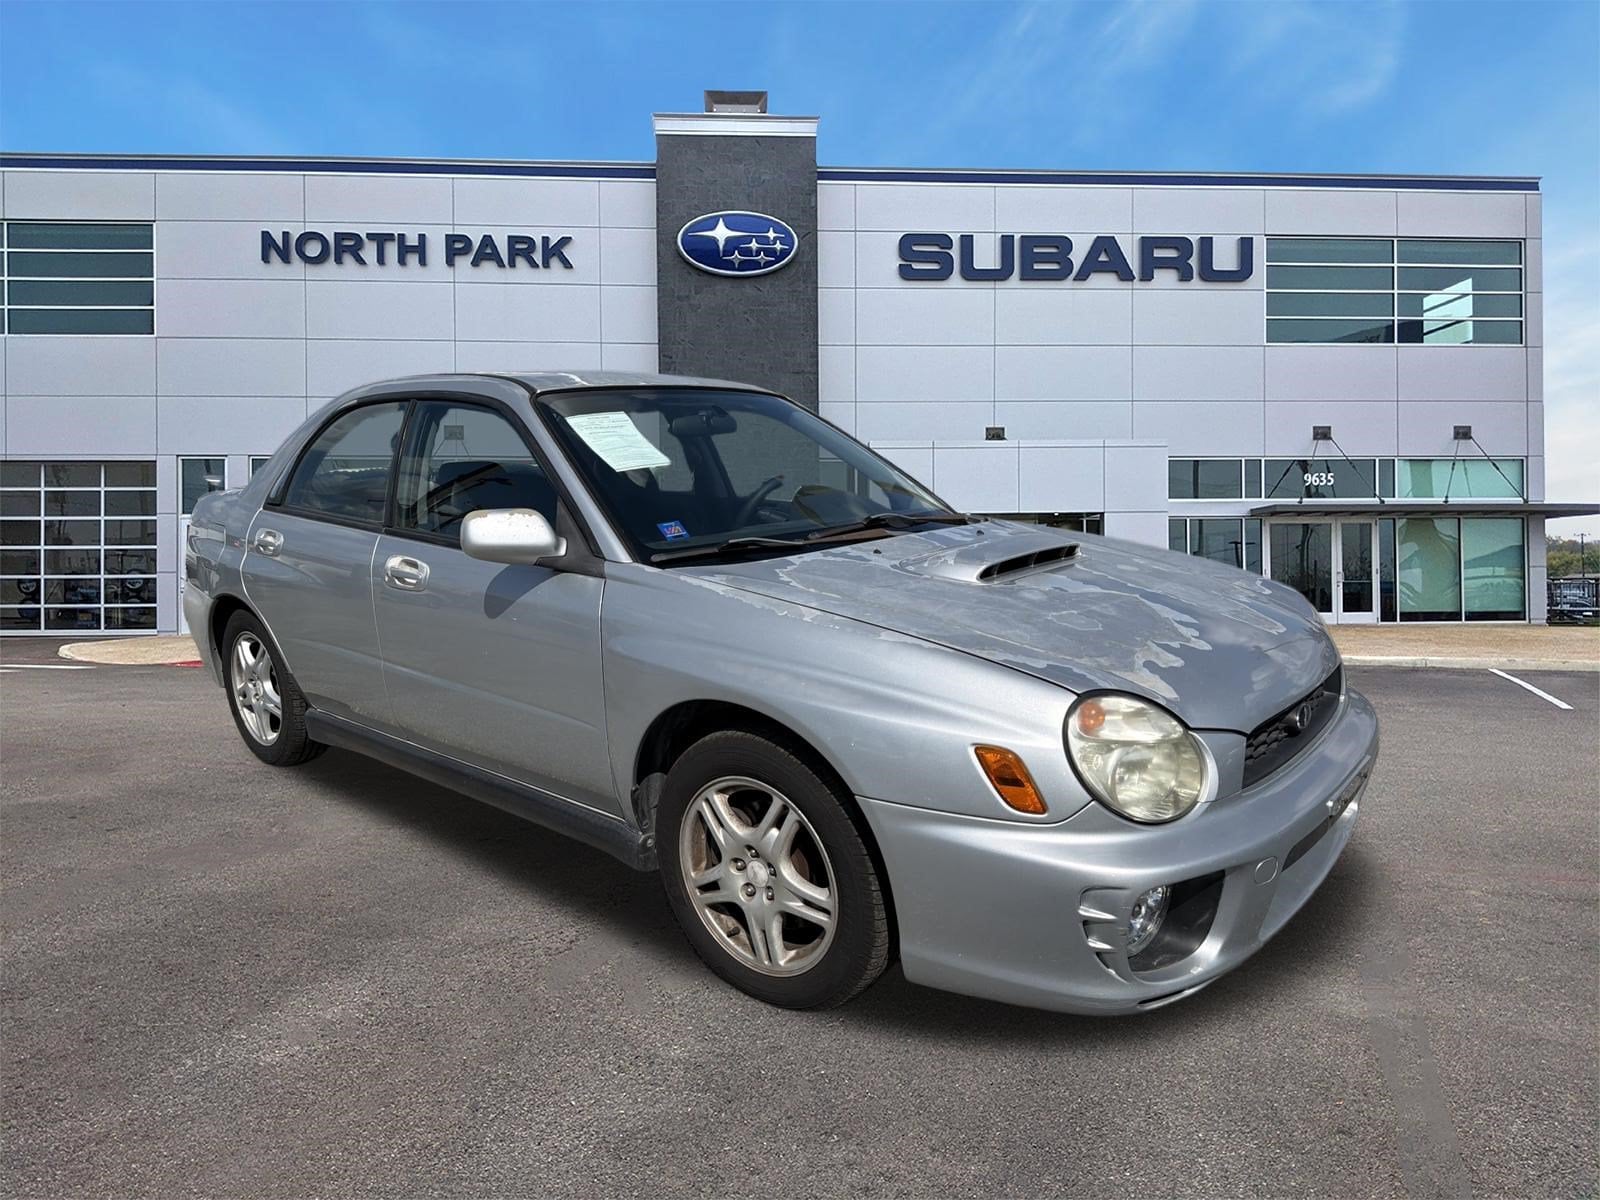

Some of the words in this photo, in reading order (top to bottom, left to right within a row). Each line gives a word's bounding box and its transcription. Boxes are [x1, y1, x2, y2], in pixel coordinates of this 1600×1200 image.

[260, 230, 427, 266] NORTH
[445, 233, 573, 269] PARK
[898, 233, 1254, 282] SUBARU
[1303, 472, 1335, 486] 9635
